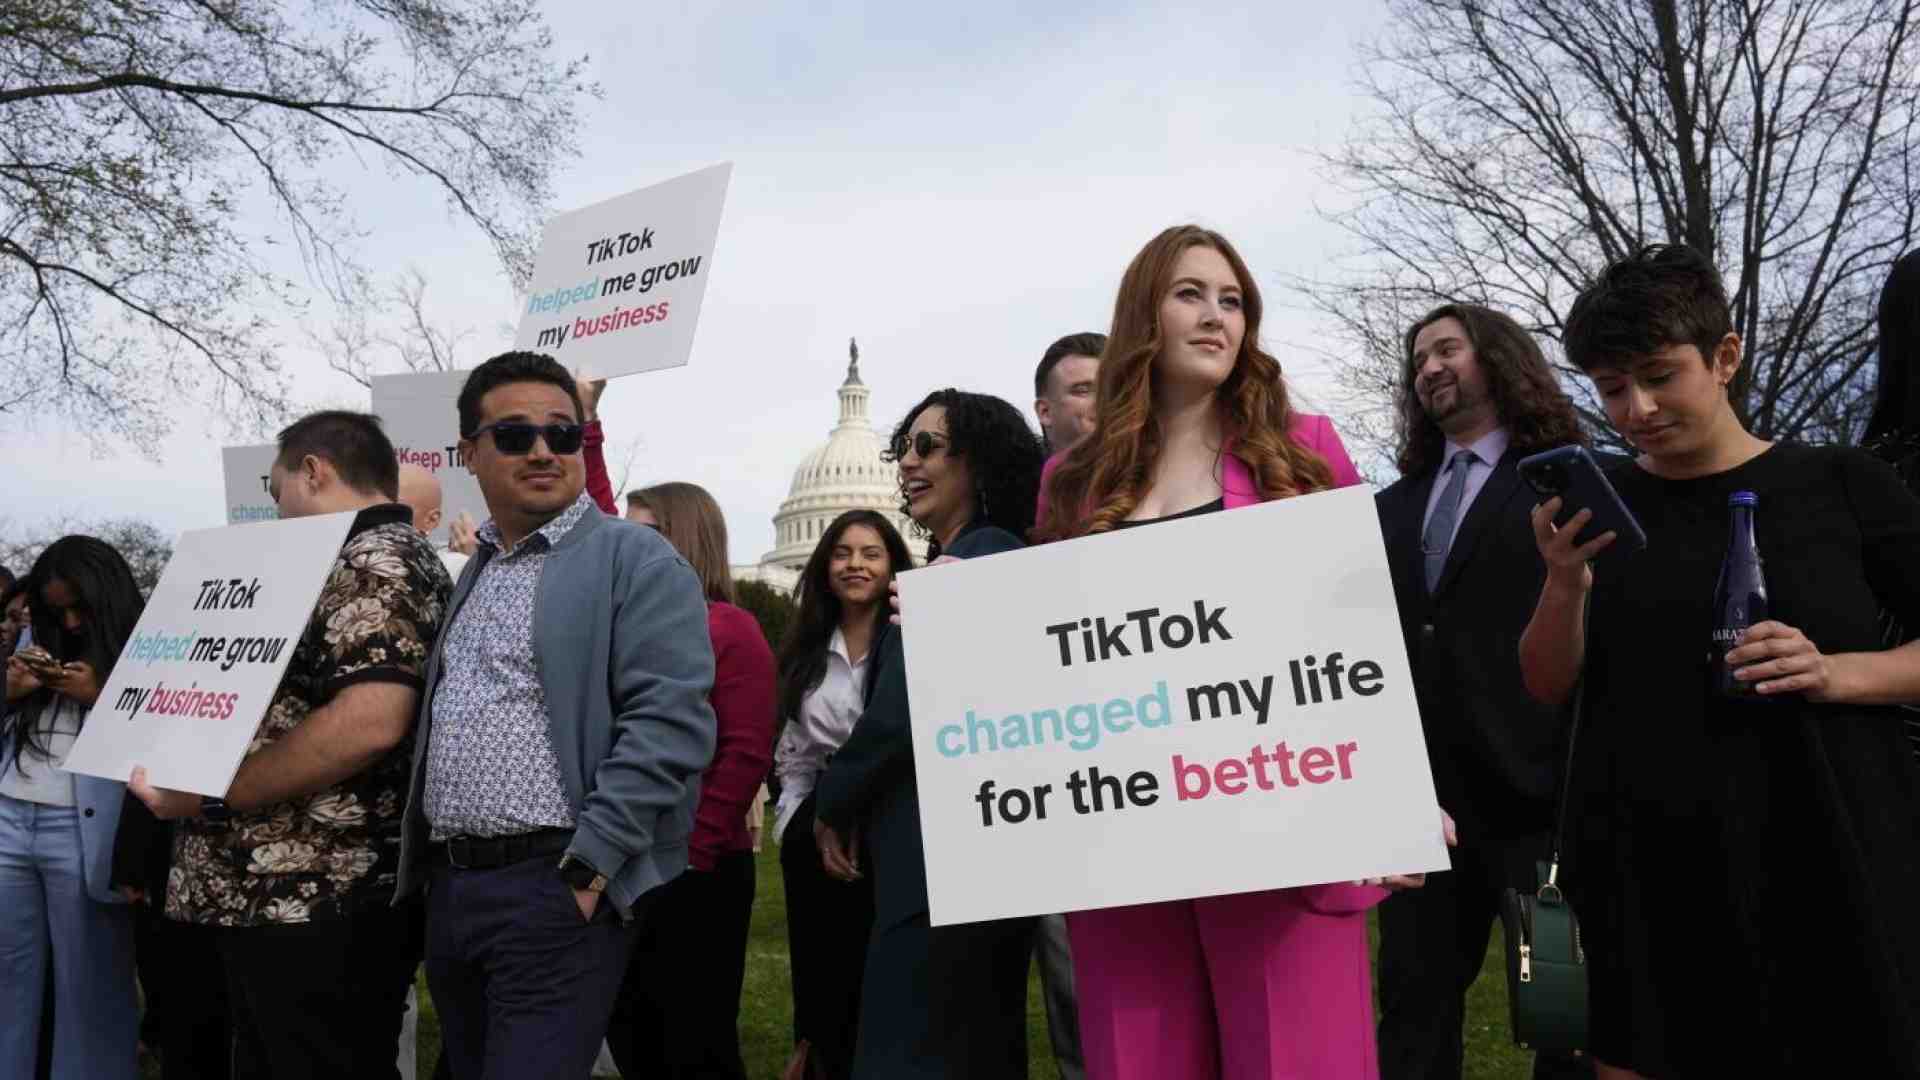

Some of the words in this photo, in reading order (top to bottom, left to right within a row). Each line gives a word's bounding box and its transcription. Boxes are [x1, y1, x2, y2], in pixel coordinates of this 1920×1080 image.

[587, 227, 655, 265] TikTok
[527, 277, 599, 316] helped
[601, 272, 636, 296] me
[639, 255, 702, 293] grow
[537, 323, 570, 349] my
[572, 301, 670, 340] business
[193, 577, 262, 611] TikTok
[126, 627, 196, 668] helped
[188, 635, 227, 663] me
[220, 636, 288, 672] grow
[1045, 599, 1233, 667] TikTok
[114, 686, 154, 721] my
[145, 682, 240, 721] business
[934, 680, 1172, 758] changed
[1186, 675, 1274, 726] my
[1288, 651, 1385, 706] life
[974, 779, 1053, 828] for
[1065, 766, 1160, 815] the
[1170, 740, 1359, 801] better
